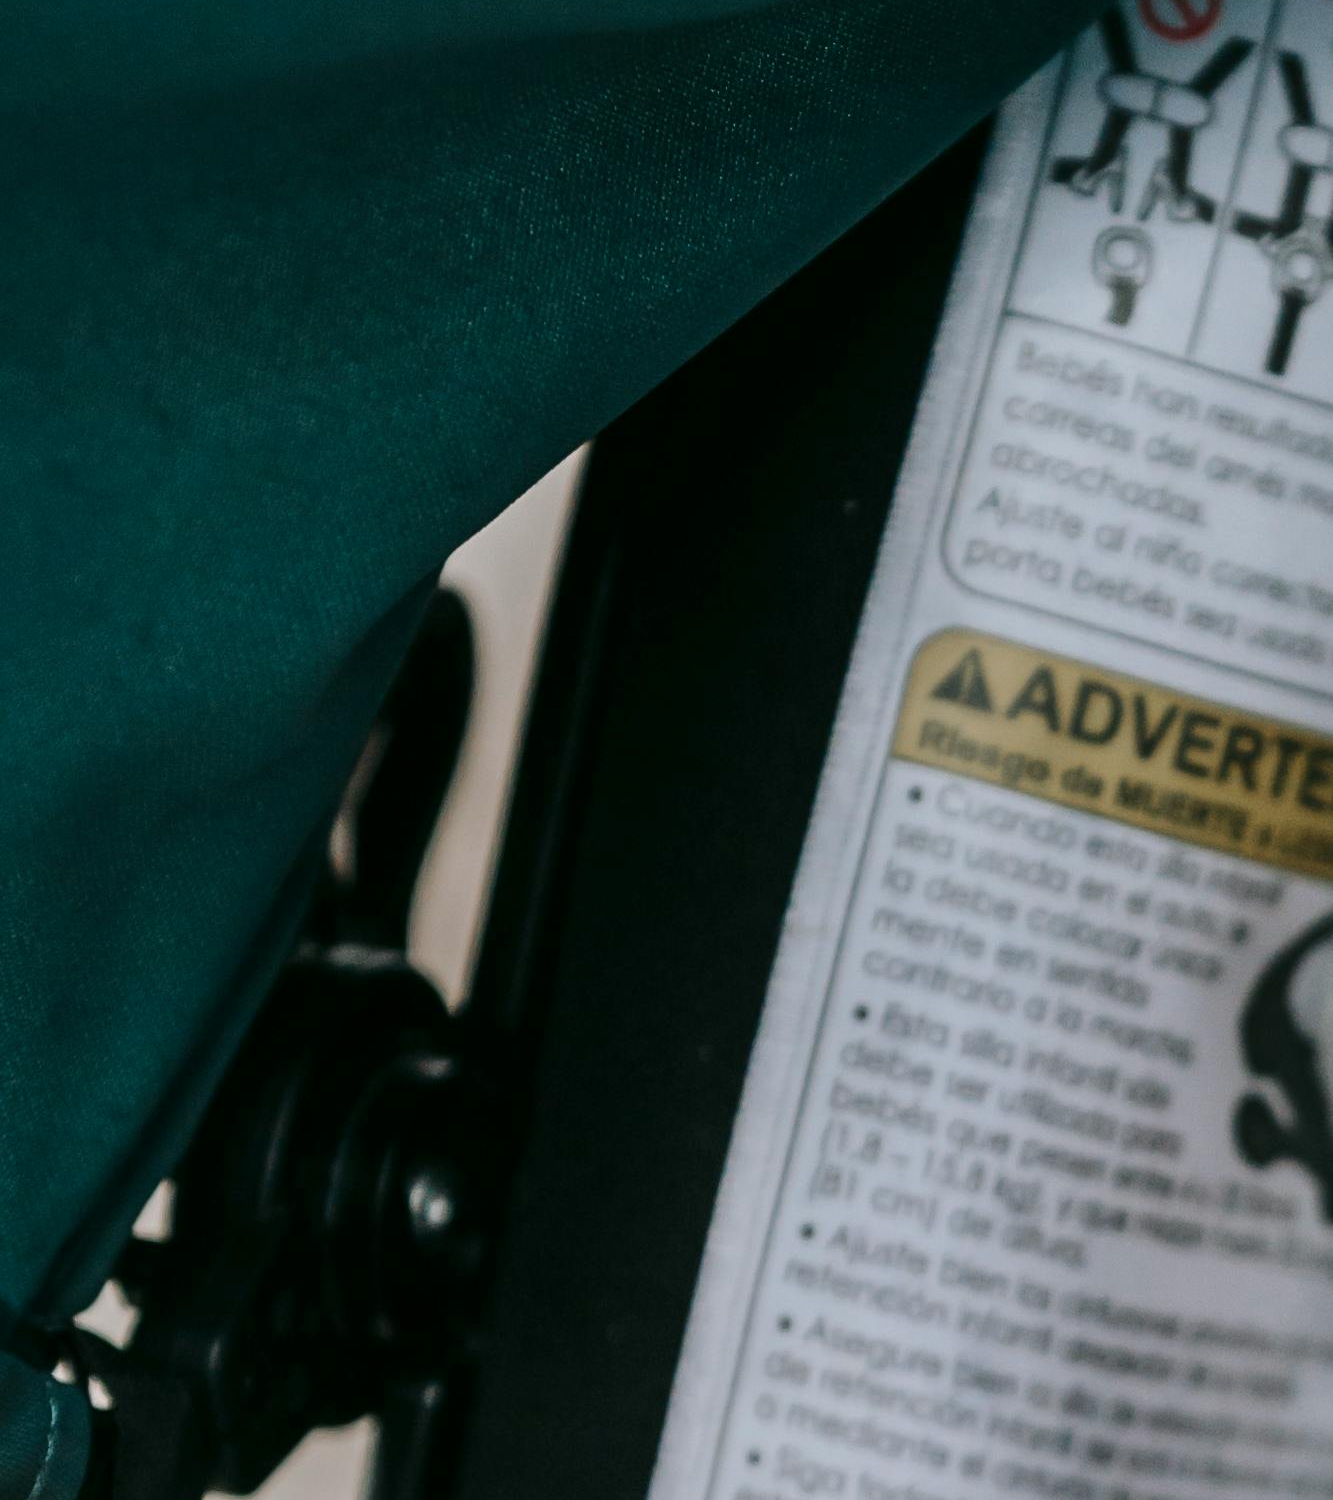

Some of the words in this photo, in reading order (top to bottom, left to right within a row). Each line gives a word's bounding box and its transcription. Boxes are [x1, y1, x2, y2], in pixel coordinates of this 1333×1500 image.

[1019, 343, 1122, 397] Bebés
[1134, 379, 1198, 419] han
[1004, 397, 1134, 453] correas
[978, 487, 1084, 540] Ajuste
[1094, 524, 1128, 553] al
[963, 538, 1063, 586] porta
[1070, 565, 1175, 619] bebés
[917, 719, 1050, 783] Riesgo
[1060, 759, 1105, 798] de
[935, 783, 1077, 850] Cuando
[895, 826, 954, 861] sea
[965, 850, 1068, 894] usada
[882, 863, 916, 895] la
[925, 877, 1018, 924] debe
[873, 908, 985, 959] mente
[863, 951, 1015, 1013] contrario
[849, 1041, 934, 1088] debe
[829, 1081, 936, 1135] bebés
[828, 1225, 930, 1275] Ajuste
[805, 1317, 943, 1377] Asegure
